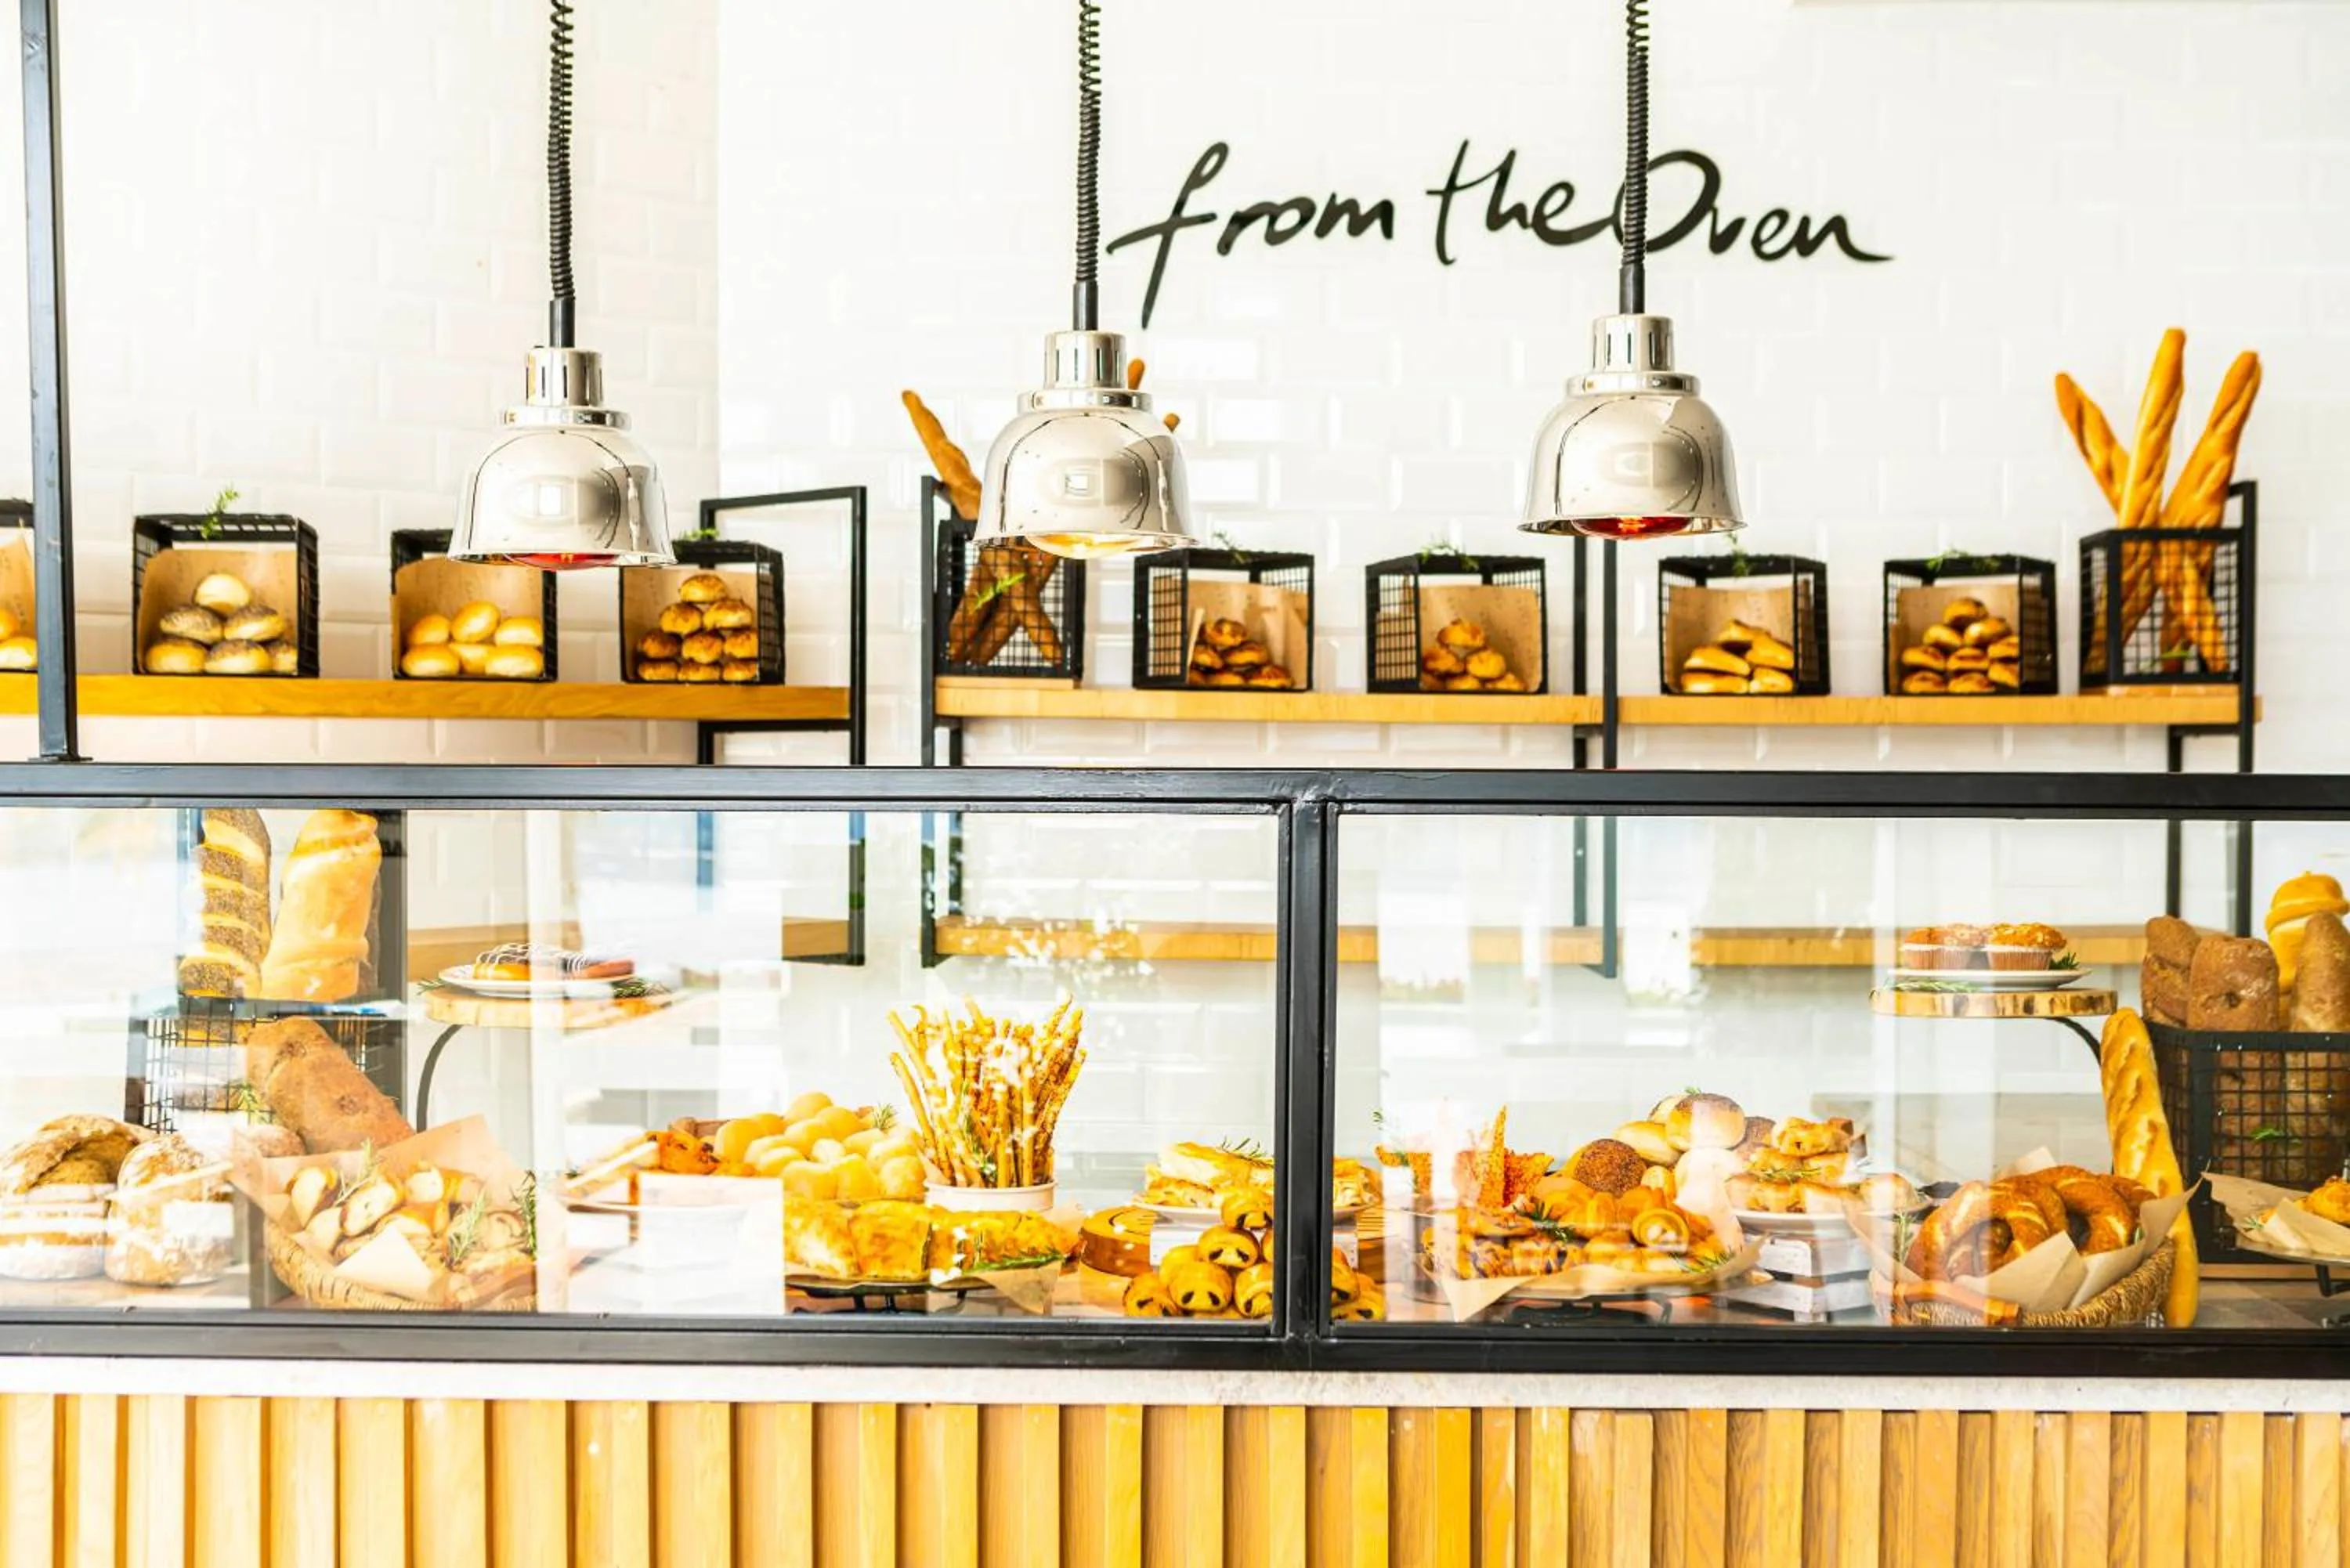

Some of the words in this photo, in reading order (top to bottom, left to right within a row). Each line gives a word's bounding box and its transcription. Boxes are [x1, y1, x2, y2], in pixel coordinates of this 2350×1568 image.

[1105, 142, 1395, 329] from
[1425, 137, 1614, 266] the
[1611, 149, 1894, 263] Oven
